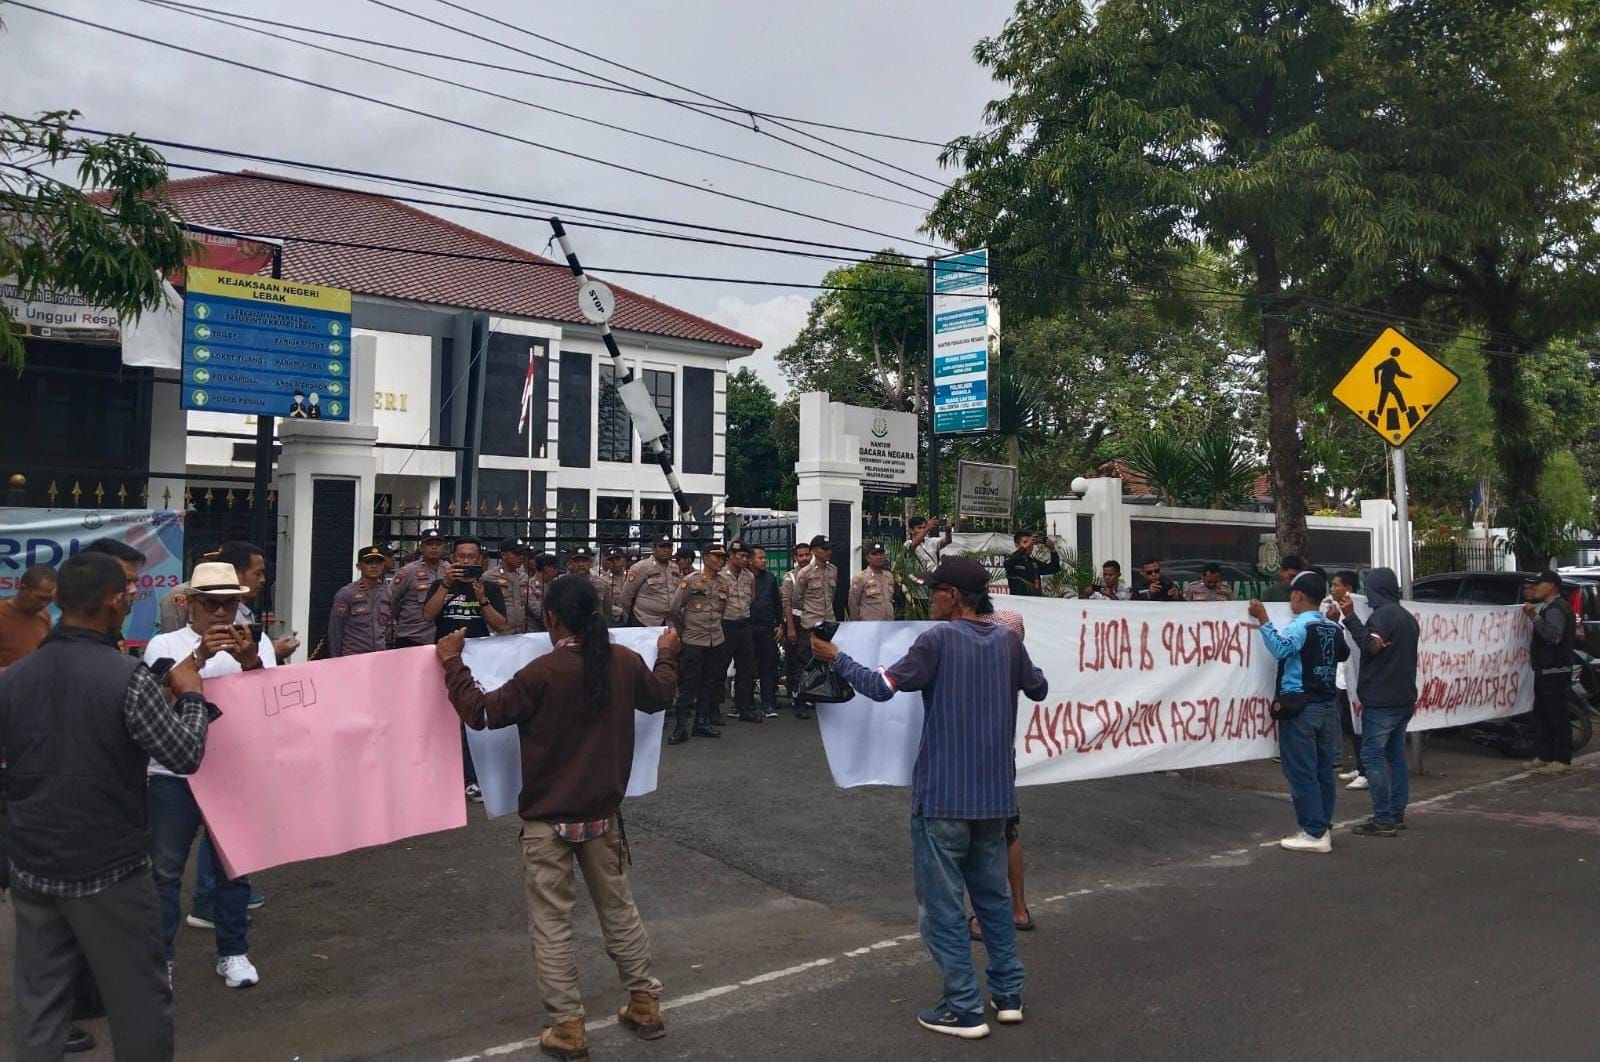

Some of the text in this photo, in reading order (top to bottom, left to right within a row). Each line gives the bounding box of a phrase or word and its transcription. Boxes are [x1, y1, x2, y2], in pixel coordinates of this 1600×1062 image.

[218, 276, 320, 298] KEJAKSAAN NEGERI
[44, 290, 88, 306] Brokrasi
[252, 291, 287, 302] LEBAK
[588, 289, 605, 313] STOP
[26, 306, 77, 325] Unggul
[888, 450, 915, 460] NEGARA
[974, 486, 999, 497] GEDUNG
